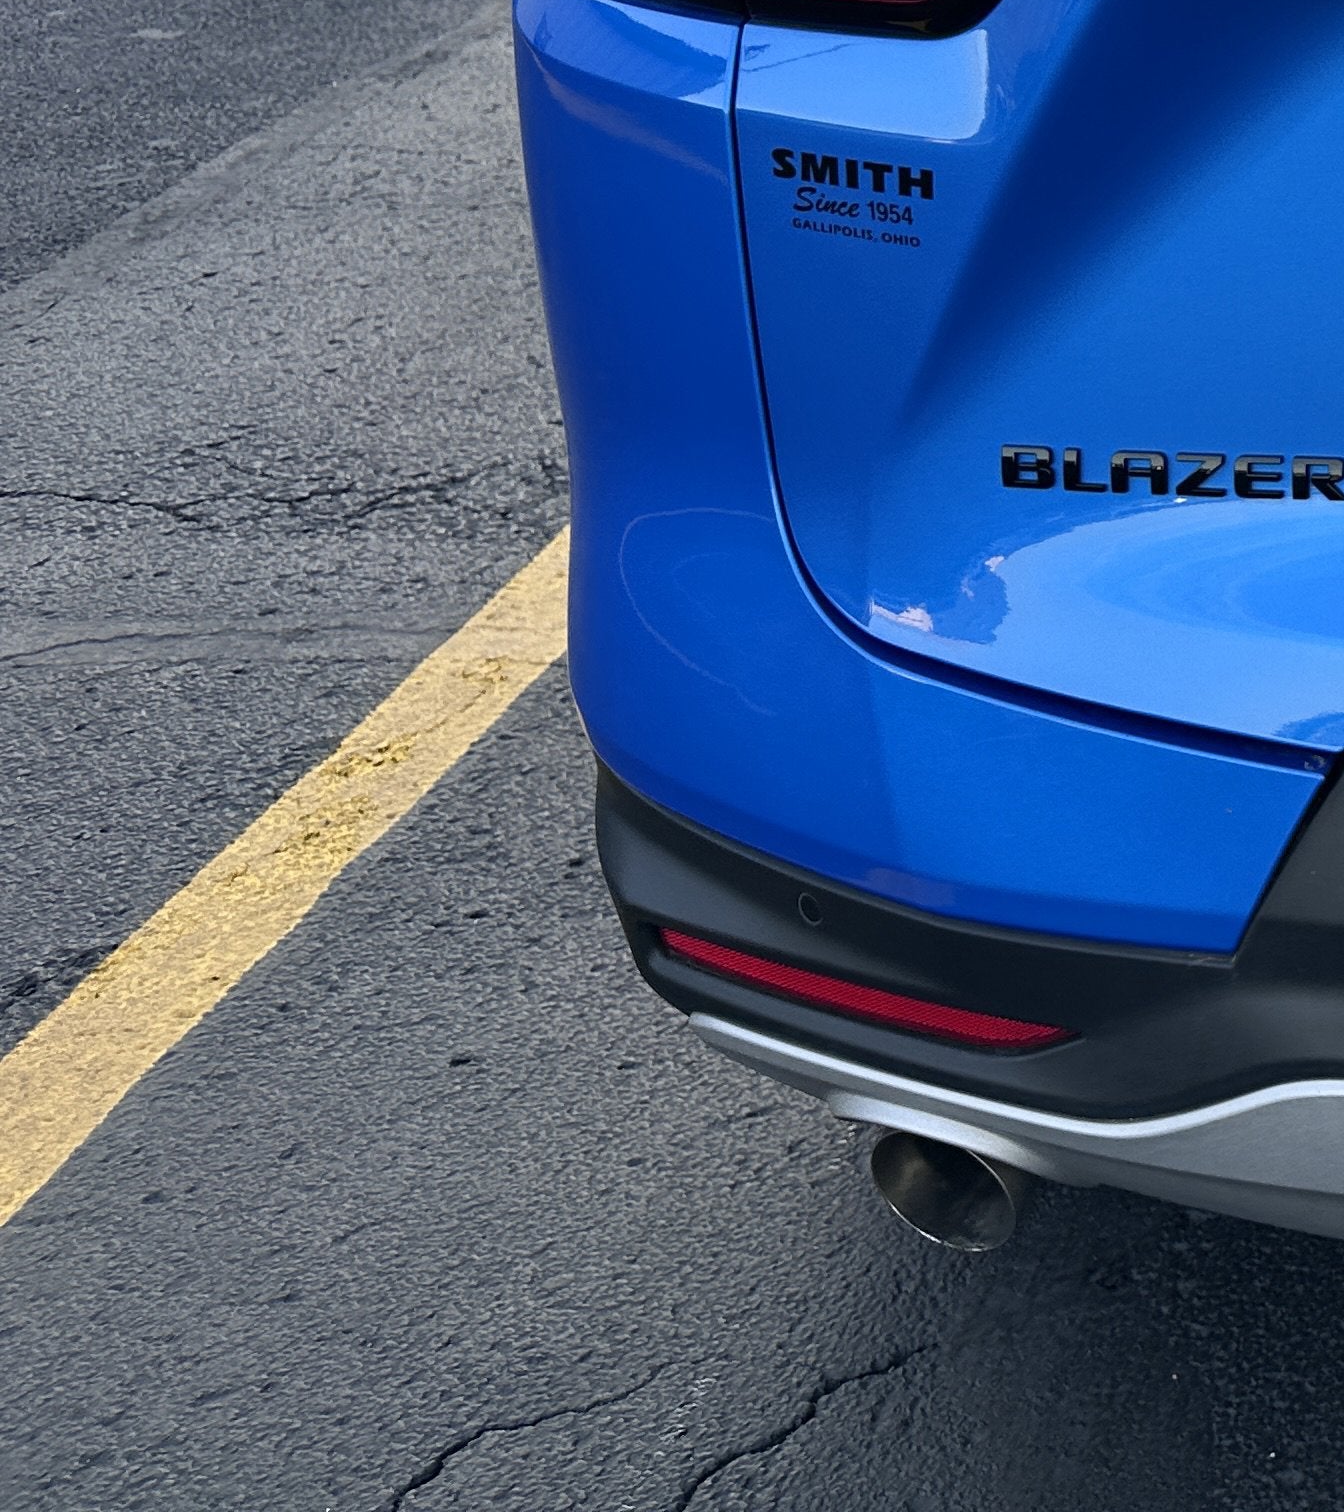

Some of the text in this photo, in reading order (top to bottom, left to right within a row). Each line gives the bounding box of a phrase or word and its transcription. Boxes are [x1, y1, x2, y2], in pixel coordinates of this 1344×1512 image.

[771, 148, 934, 200] SMITH
[793, 186, 913, 225] Since 1954
[881, 232, 921, 248] OHIO
